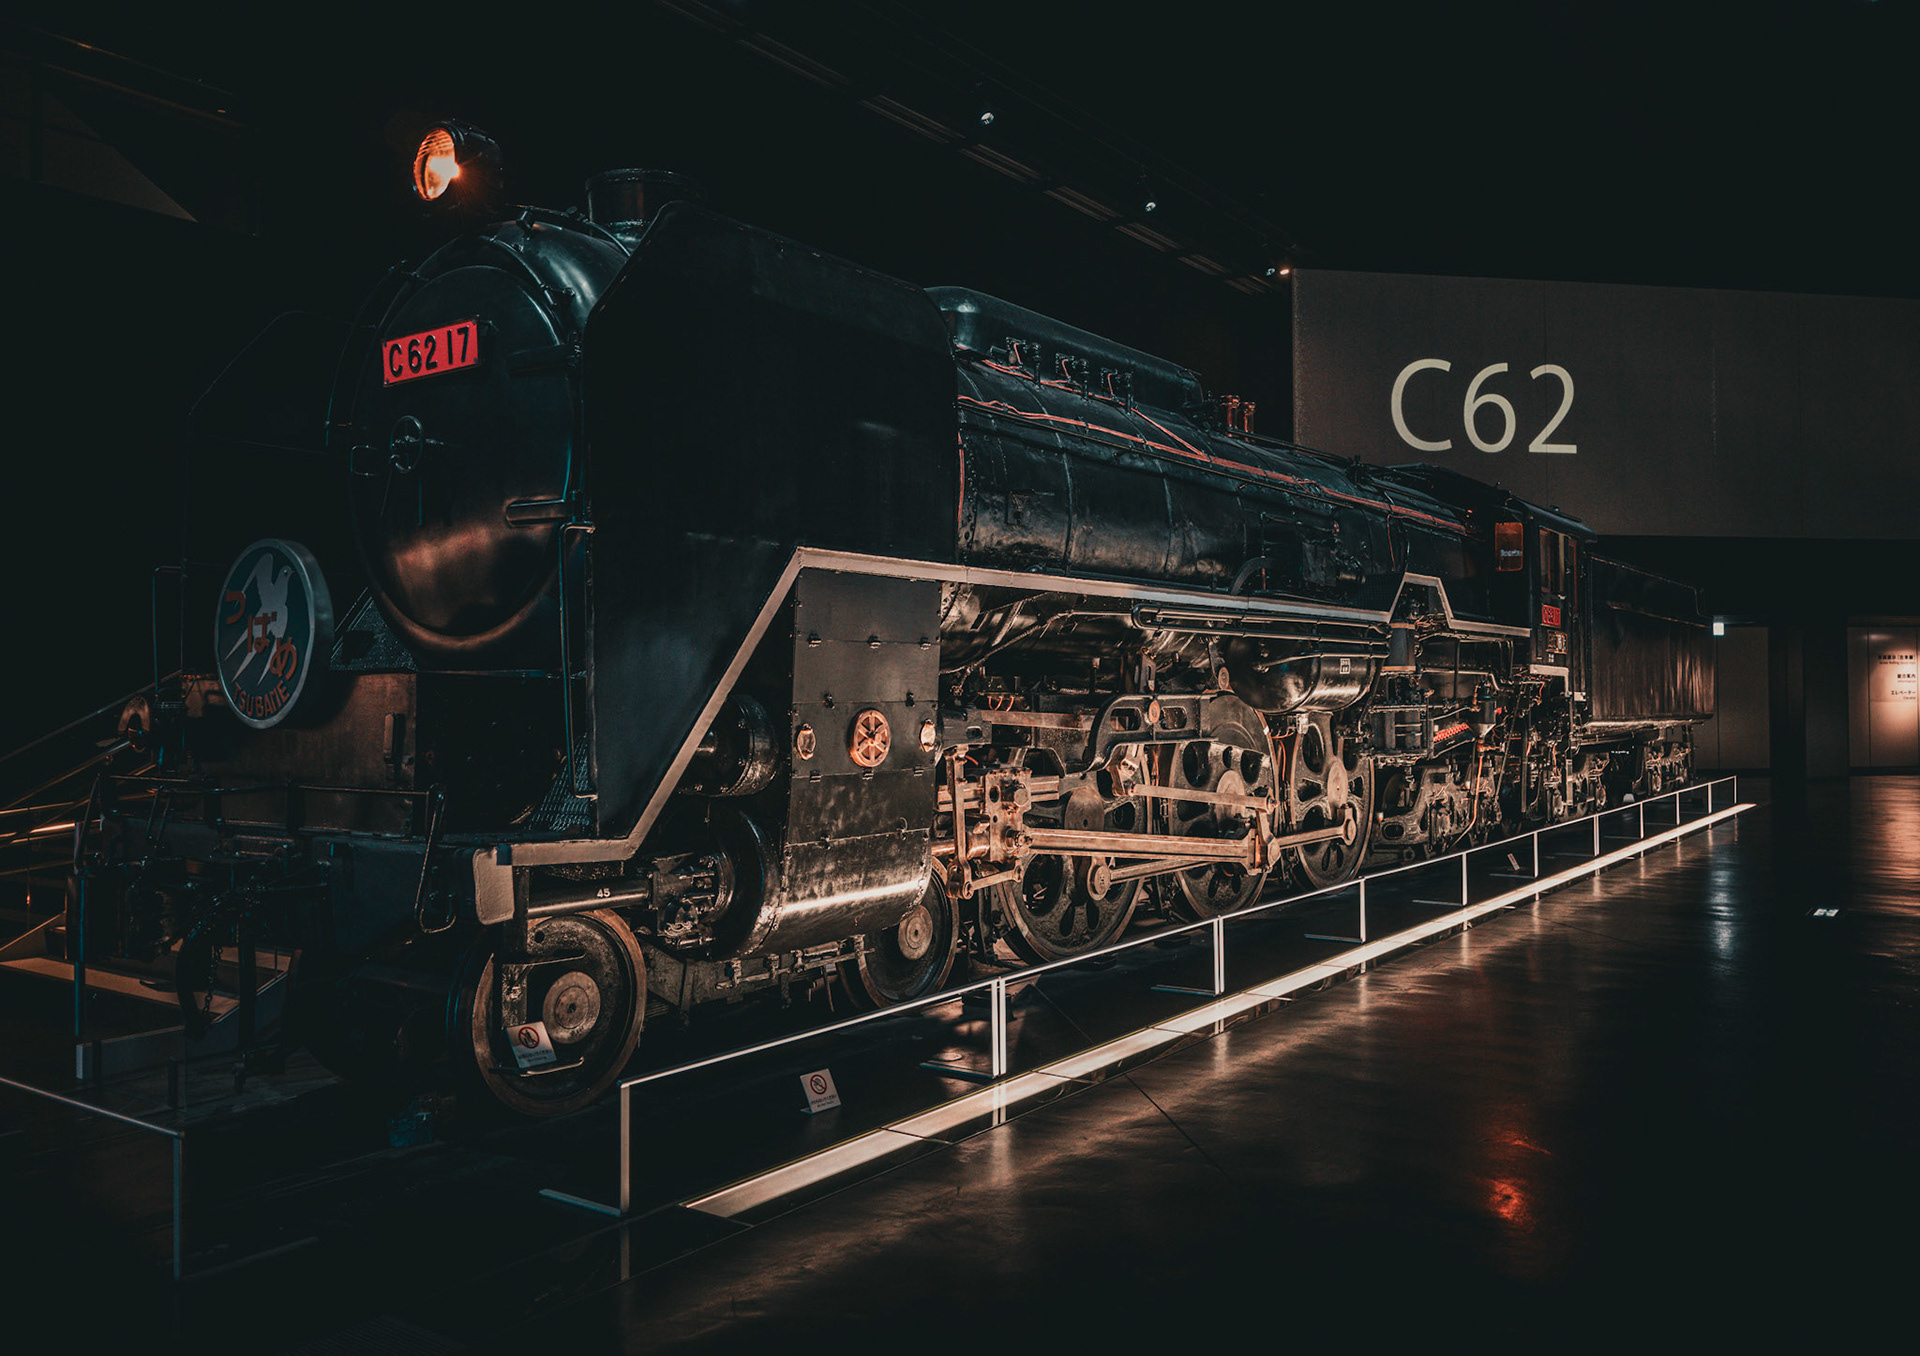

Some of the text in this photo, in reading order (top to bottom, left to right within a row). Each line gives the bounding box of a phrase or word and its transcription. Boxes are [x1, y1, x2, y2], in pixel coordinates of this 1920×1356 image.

[389, 325, 469, 377] C62 17
[1390, 358, 1578, 455] C62
[225, 590, 298, 682] つばめ
[232, 680, 290, 718] TSUBAME
[596, 887, 611, 898] 45
